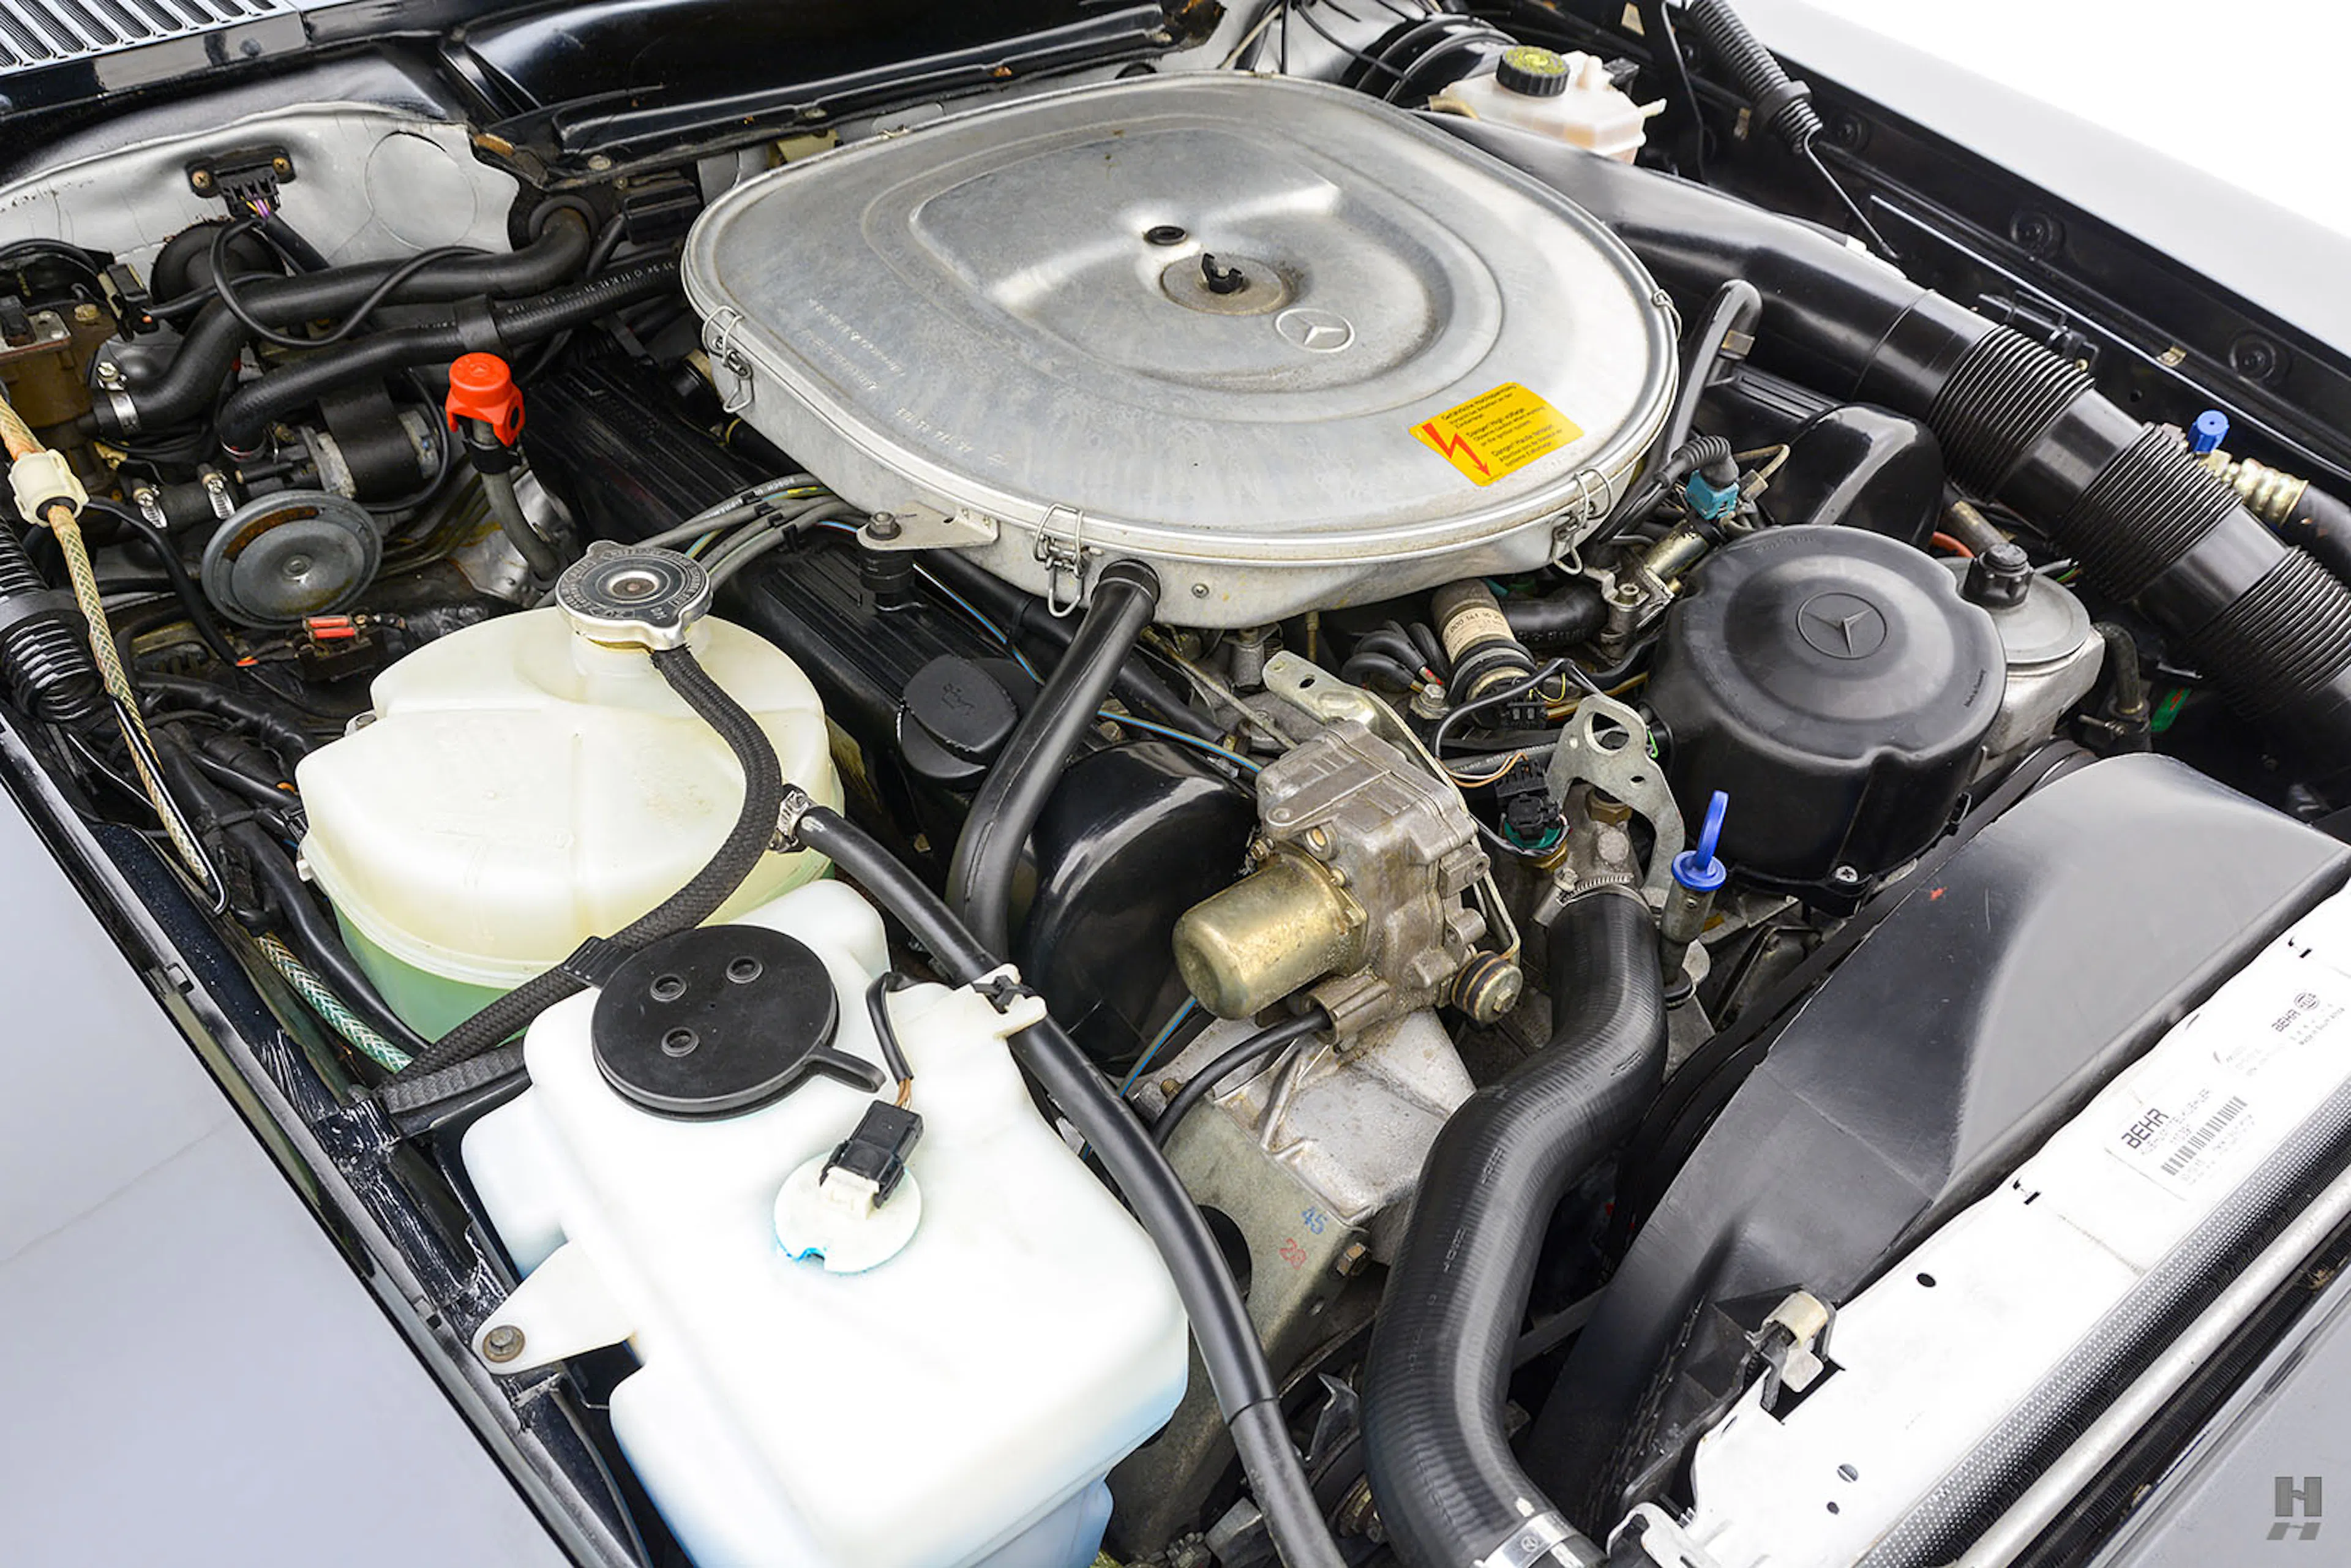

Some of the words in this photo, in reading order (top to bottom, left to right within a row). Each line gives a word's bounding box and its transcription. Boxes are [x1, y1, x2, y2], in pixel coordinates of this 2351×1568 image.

[2271, 1008, 2301, 1032] BEHR
[2121, 1107, 2170, 1149] BEHR
[1300, 1206, 1328, 1235] 45
